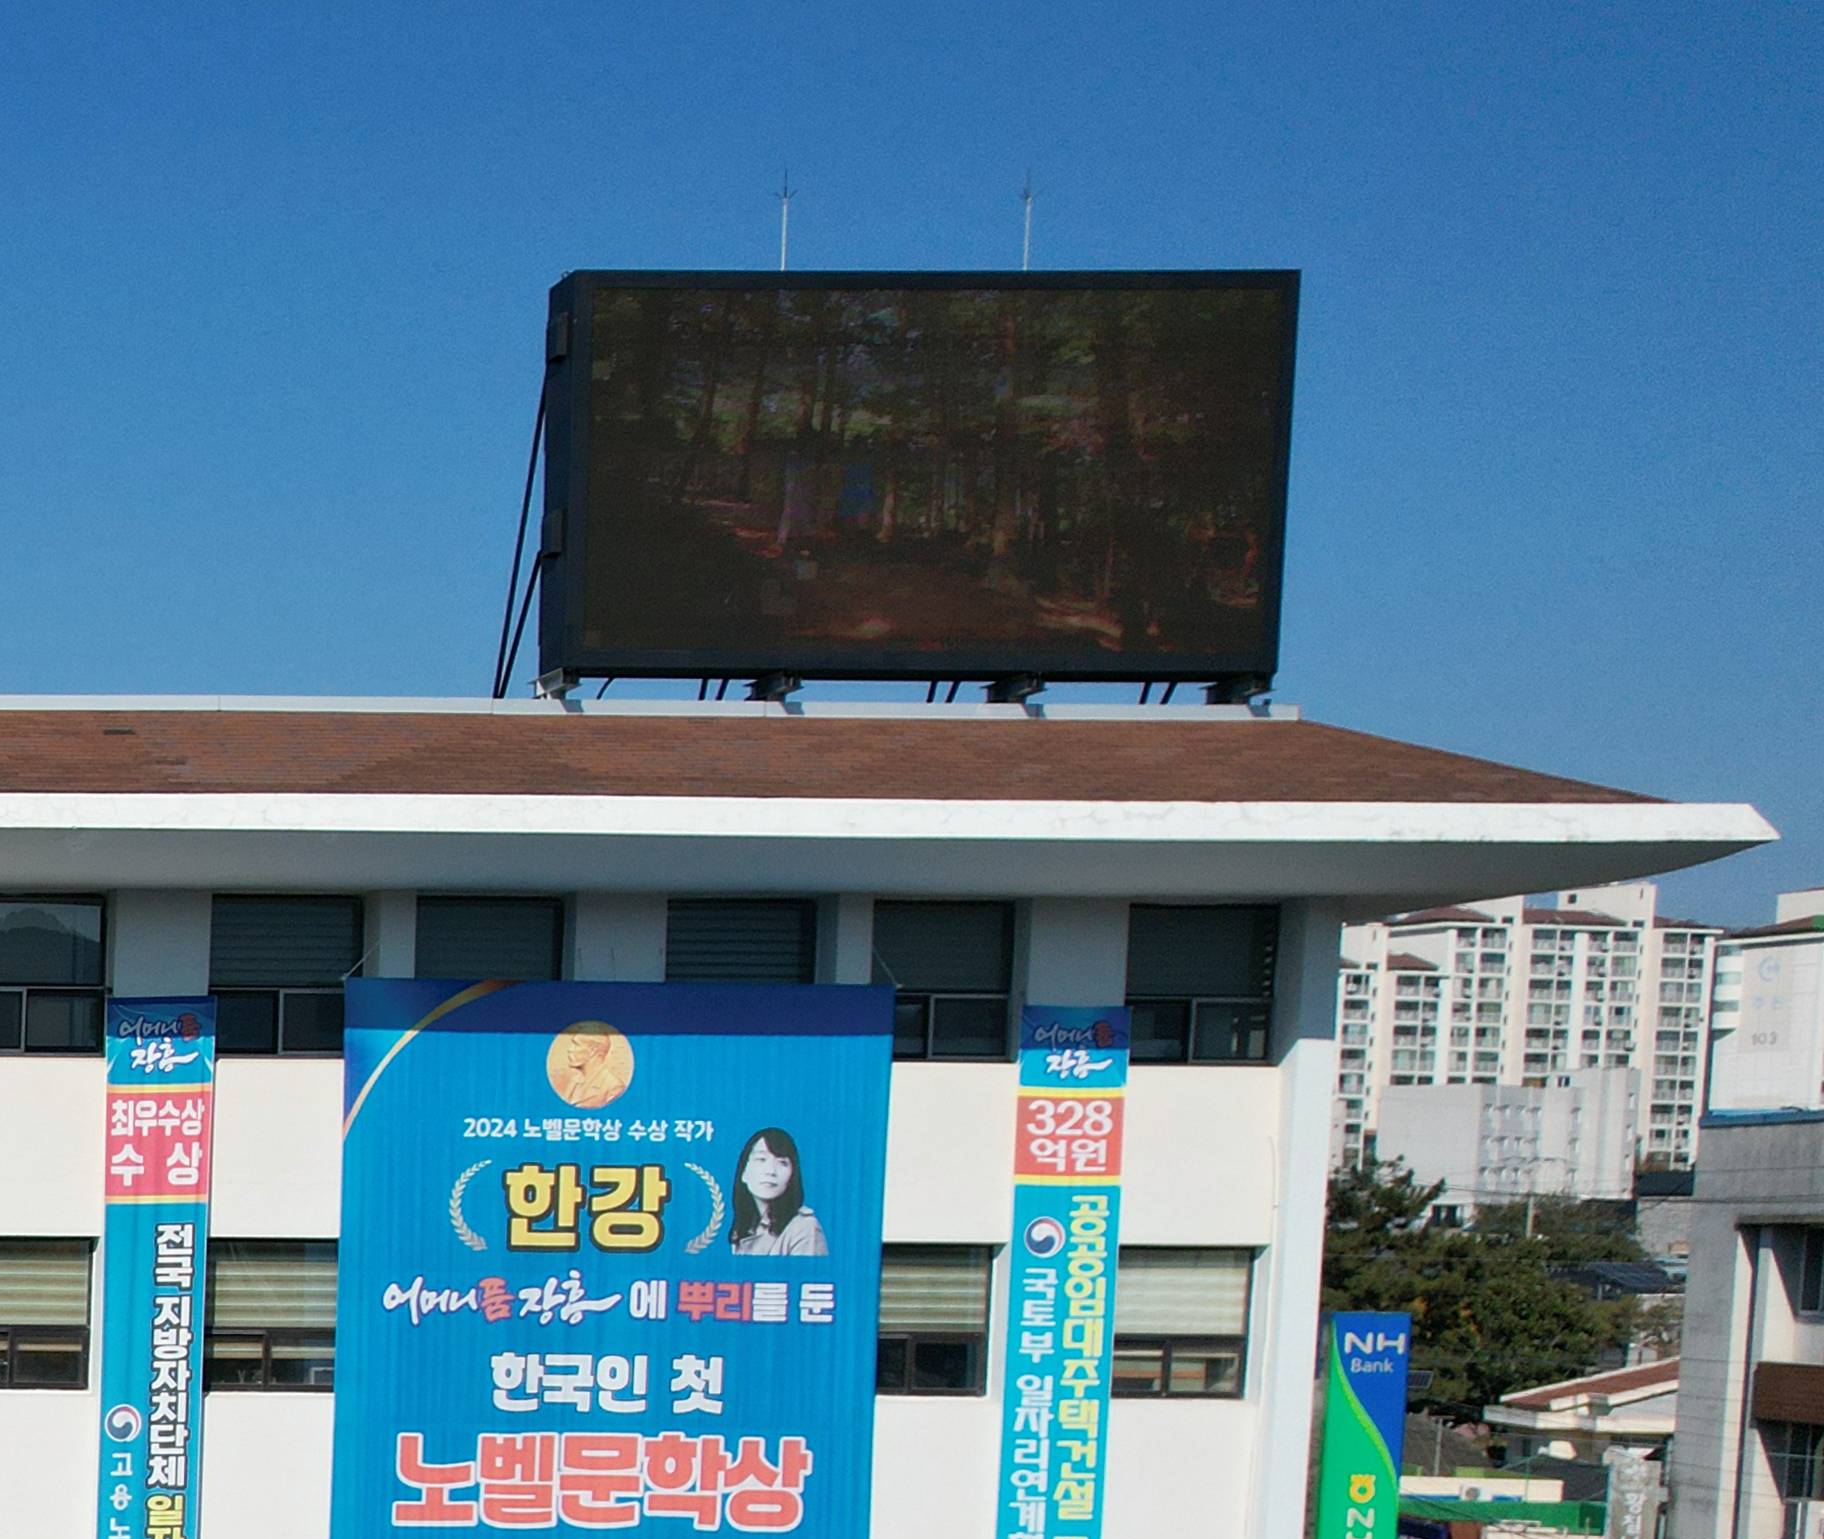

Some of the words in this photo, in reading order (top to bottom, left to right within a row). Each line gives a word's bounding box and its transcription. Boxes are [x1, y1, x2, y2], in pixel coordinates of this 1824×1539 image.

[110, 1098, 206, 1138] 최우수상
[463, 1117, 518, 1138] 2024
[523, 1117, 623, 1142] 노벨문학상
[628, 1119, 669, 1142] 수상
[674, 1119, 715, 1142] 작가
[1025, 1099, 1114, 1137] 328
[1028, 1137, 1108, 1173] 억원
[502, 1160, 672, 1254] 한강
[153, 1222, 194, 1290] 전국
[676, 1280, 790, 1325] 뿌리를
[798, 1282, 836, 1326] 둔
[1019, 1265, 1060, 1365] 국토부
[1344, 1331, 1406, 1355] NH
[1350, 1357, 1394, 1375] Bank
[145, 1295, 193, 1490] 지방자치단체
[489, 1351, 649, 1415] 한국인
[671, 1352, 724, 1416] 첫
[391, 1431, 812, 1534] 노벨문학상
